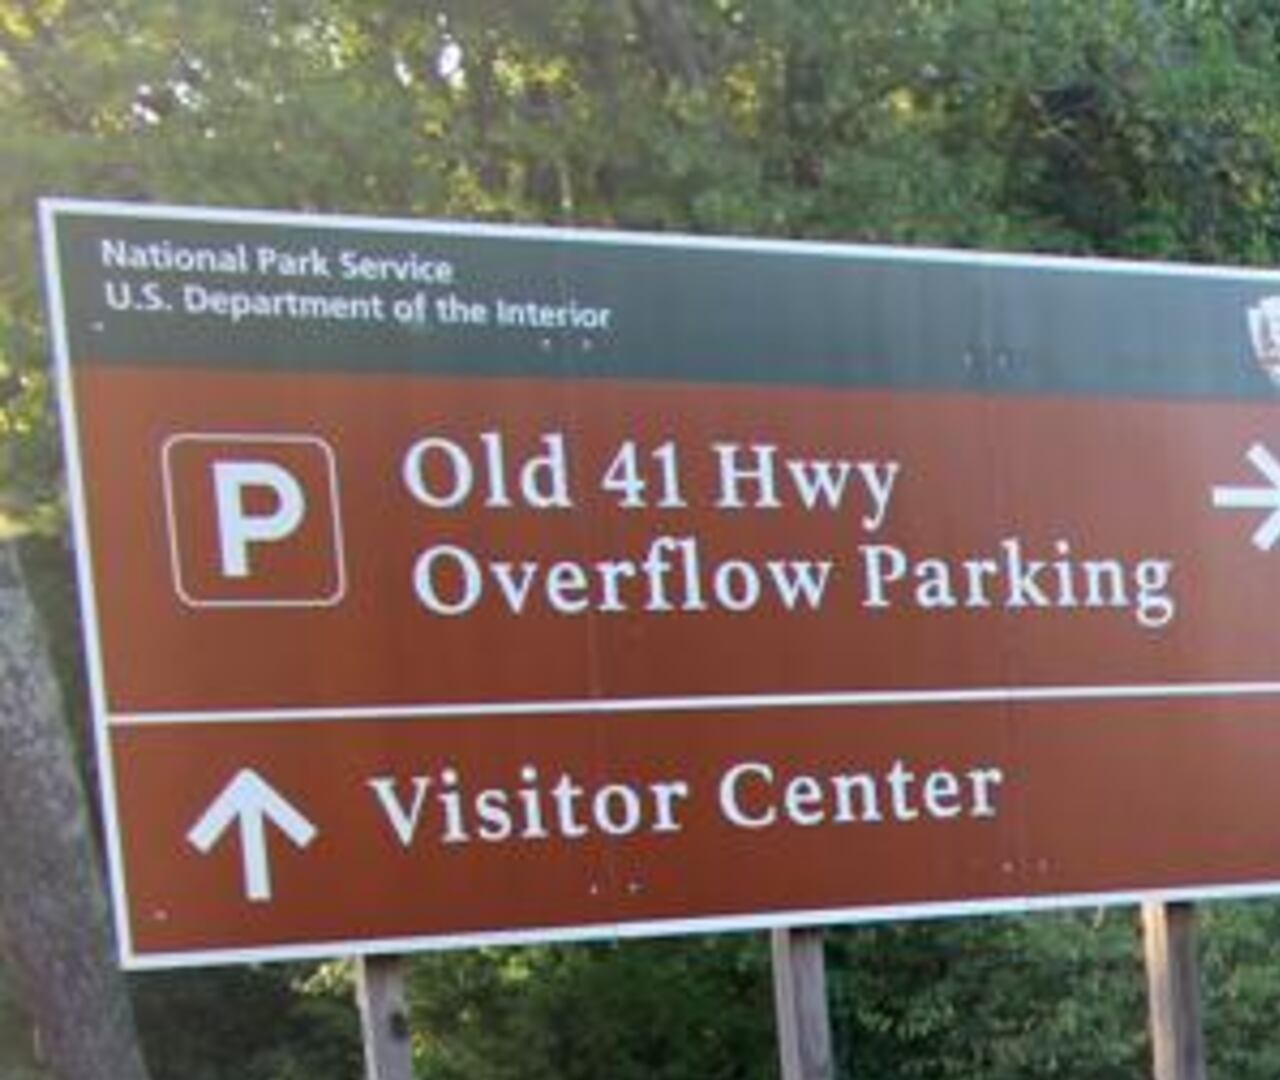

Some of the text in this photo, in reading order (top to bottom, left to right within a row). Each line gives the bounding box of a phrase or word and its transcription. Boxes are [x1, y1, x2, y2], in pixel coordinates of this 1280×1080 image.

[101, 239, 453, 283] National Park Service
[105, 282, 612, 329] U.S. Department of the Interior
[211, 460, 306, 578] P
[403, 431, 900, 532] Old 41 Hwy
[413, 535, 1176, 628] Overflow Parking
[366, 760, 1004, 846] Visitor Center
